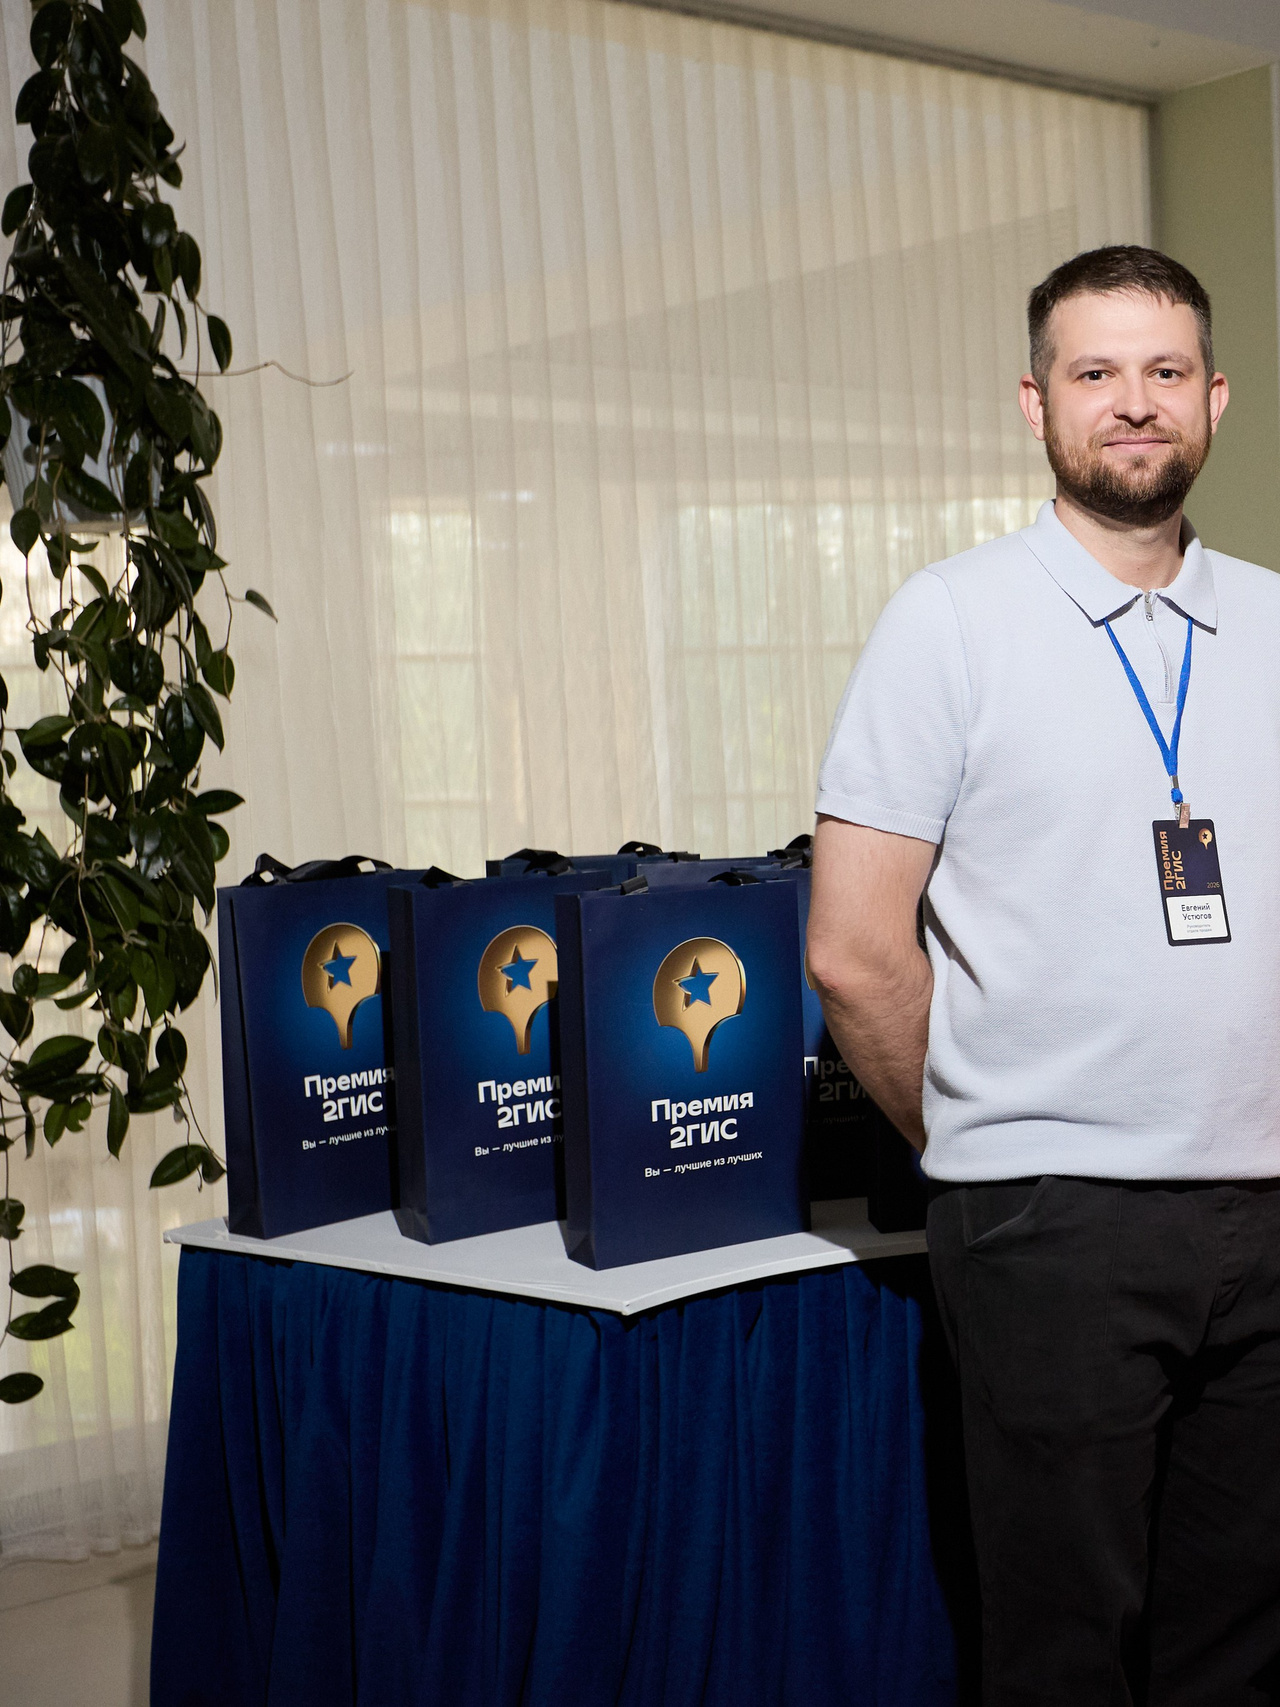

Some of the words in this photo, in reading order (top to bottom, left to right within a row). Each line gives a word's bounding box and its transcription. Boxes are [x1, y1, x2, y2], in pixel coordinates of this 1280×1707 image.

[1159, 831, 1175, 890] Премия
[1171, 850, 1186, 890] 2ГИС
[1181, 903, 1210, 912] Евгений
[1182, 913, 1212, 921] Устюгов
[304, 1067, 394, 1100] Премия
[803, 1056, 850, 1080] Пре
[478, 1074, 560, 1106] Преми
[818, 1079, 866, 1102] 2ГИ
[322, 1091, 384, 1122] 2ГИС
[497, 1098, 562, 1129] 2ГИС
[651, 1091, 754, 1125] Премия
[302, 1140, 317, 1151] Вы
[328, 1130, 362, 1146] лучшие
[363, 1128, 374, 1138] из
[475, 1146, 489, 1157] Вы
[502, 1137, 539, 1152] лучшие
[540, 1135, 552, 1145] из
[670, 1118, 738, 1149] 2ГИС
[644, 1167, 660, 1178] Вы
[674, 1160, 712, 1174] лучшие
[713, 1157, 725, 1167] из
[727, 1151, 763, 1165] лучших
